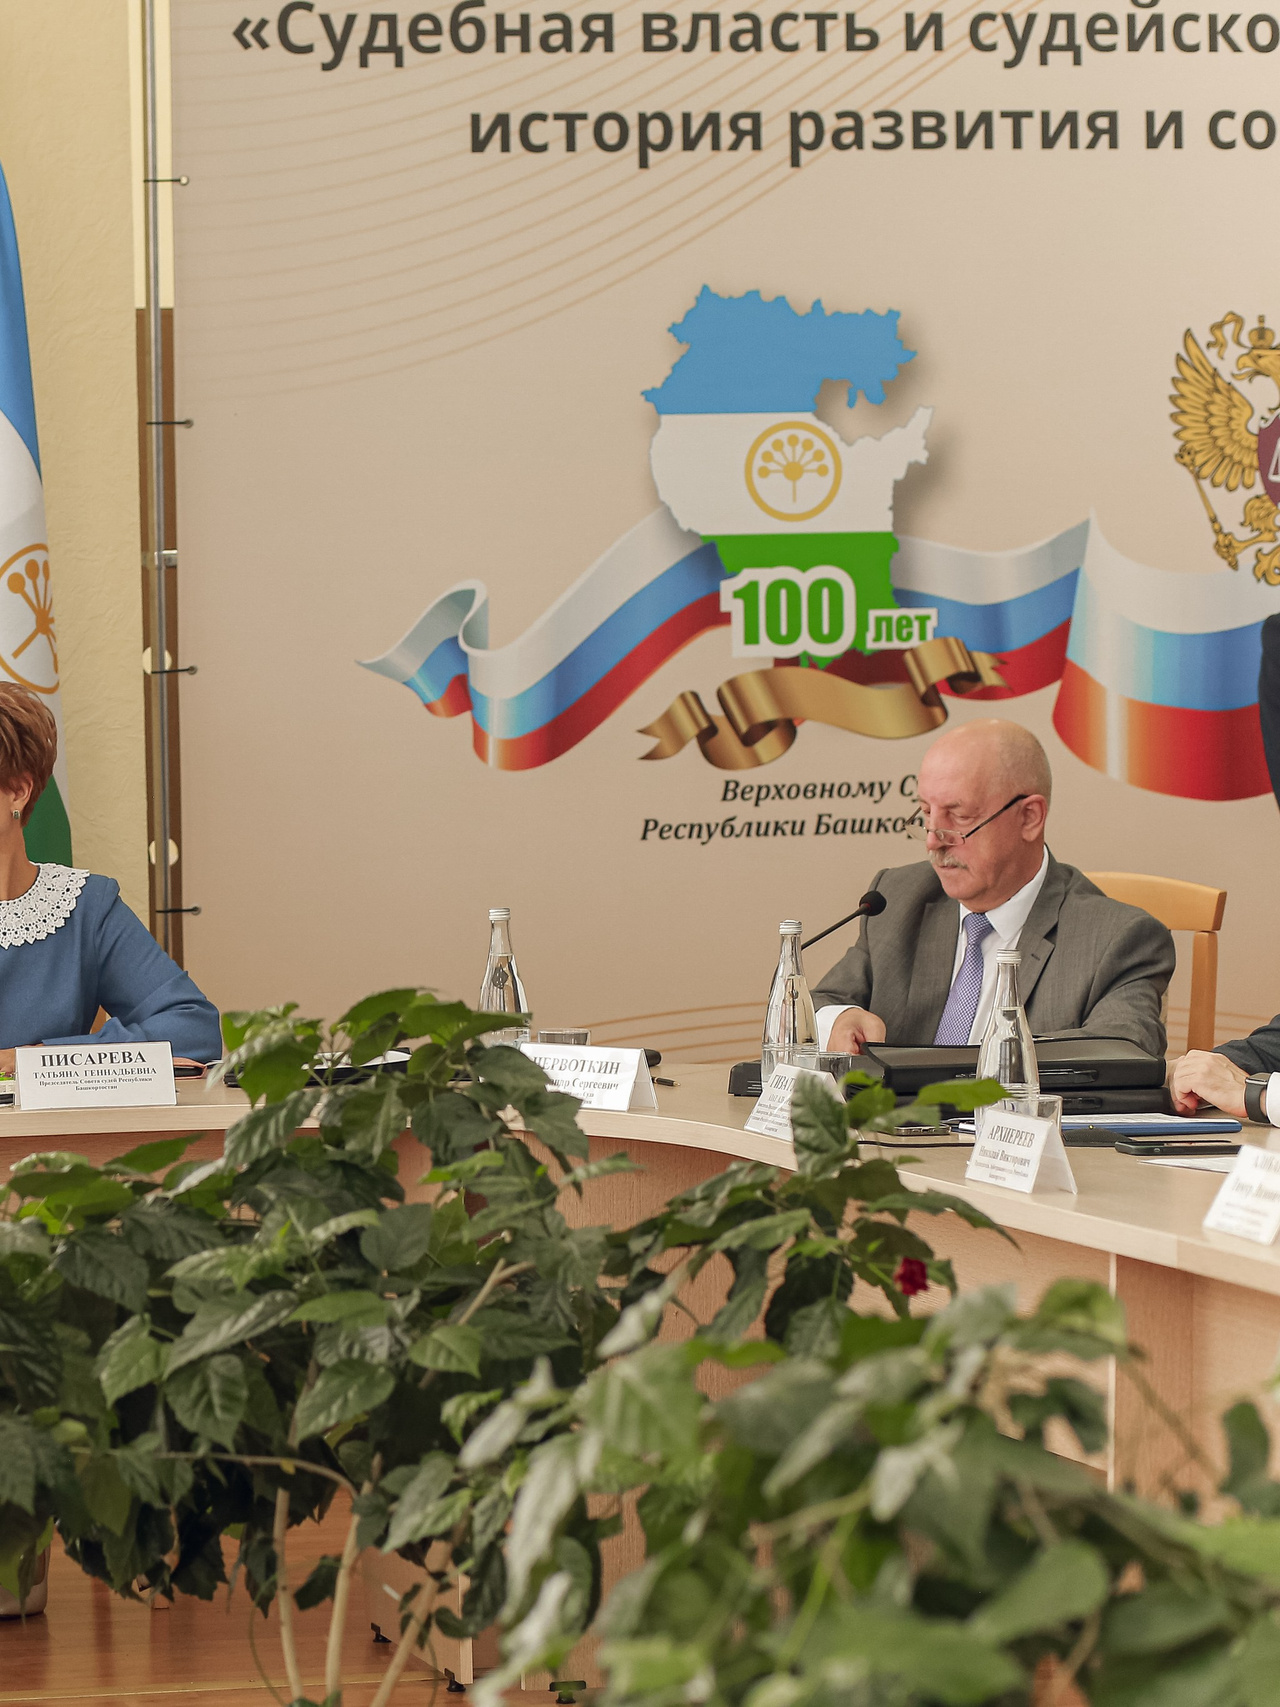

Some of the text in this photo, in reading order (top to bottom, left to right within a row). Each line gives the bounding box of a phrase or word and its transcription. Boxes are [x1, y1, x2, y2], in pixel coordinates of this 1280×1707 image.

[232, 0, 614, 71] «Судебная
[642, 11, 880, 53] власть
[905, 12, 944, 52] и
[470, 109, 1277, 169] история развития и со
[732, 577, 934, 646] 100 лет
[721, 774, 919, 807] Верховному С
[640, 815, 806, 845] Республики
[32, 1067, 157, 1080] ТАТЬЯНА ГЕННАДЬЕВНА
[41, 1050, 147, 1067] ПИСАРЕВА
[572, 1077, 619, 1090] Сергеевич
